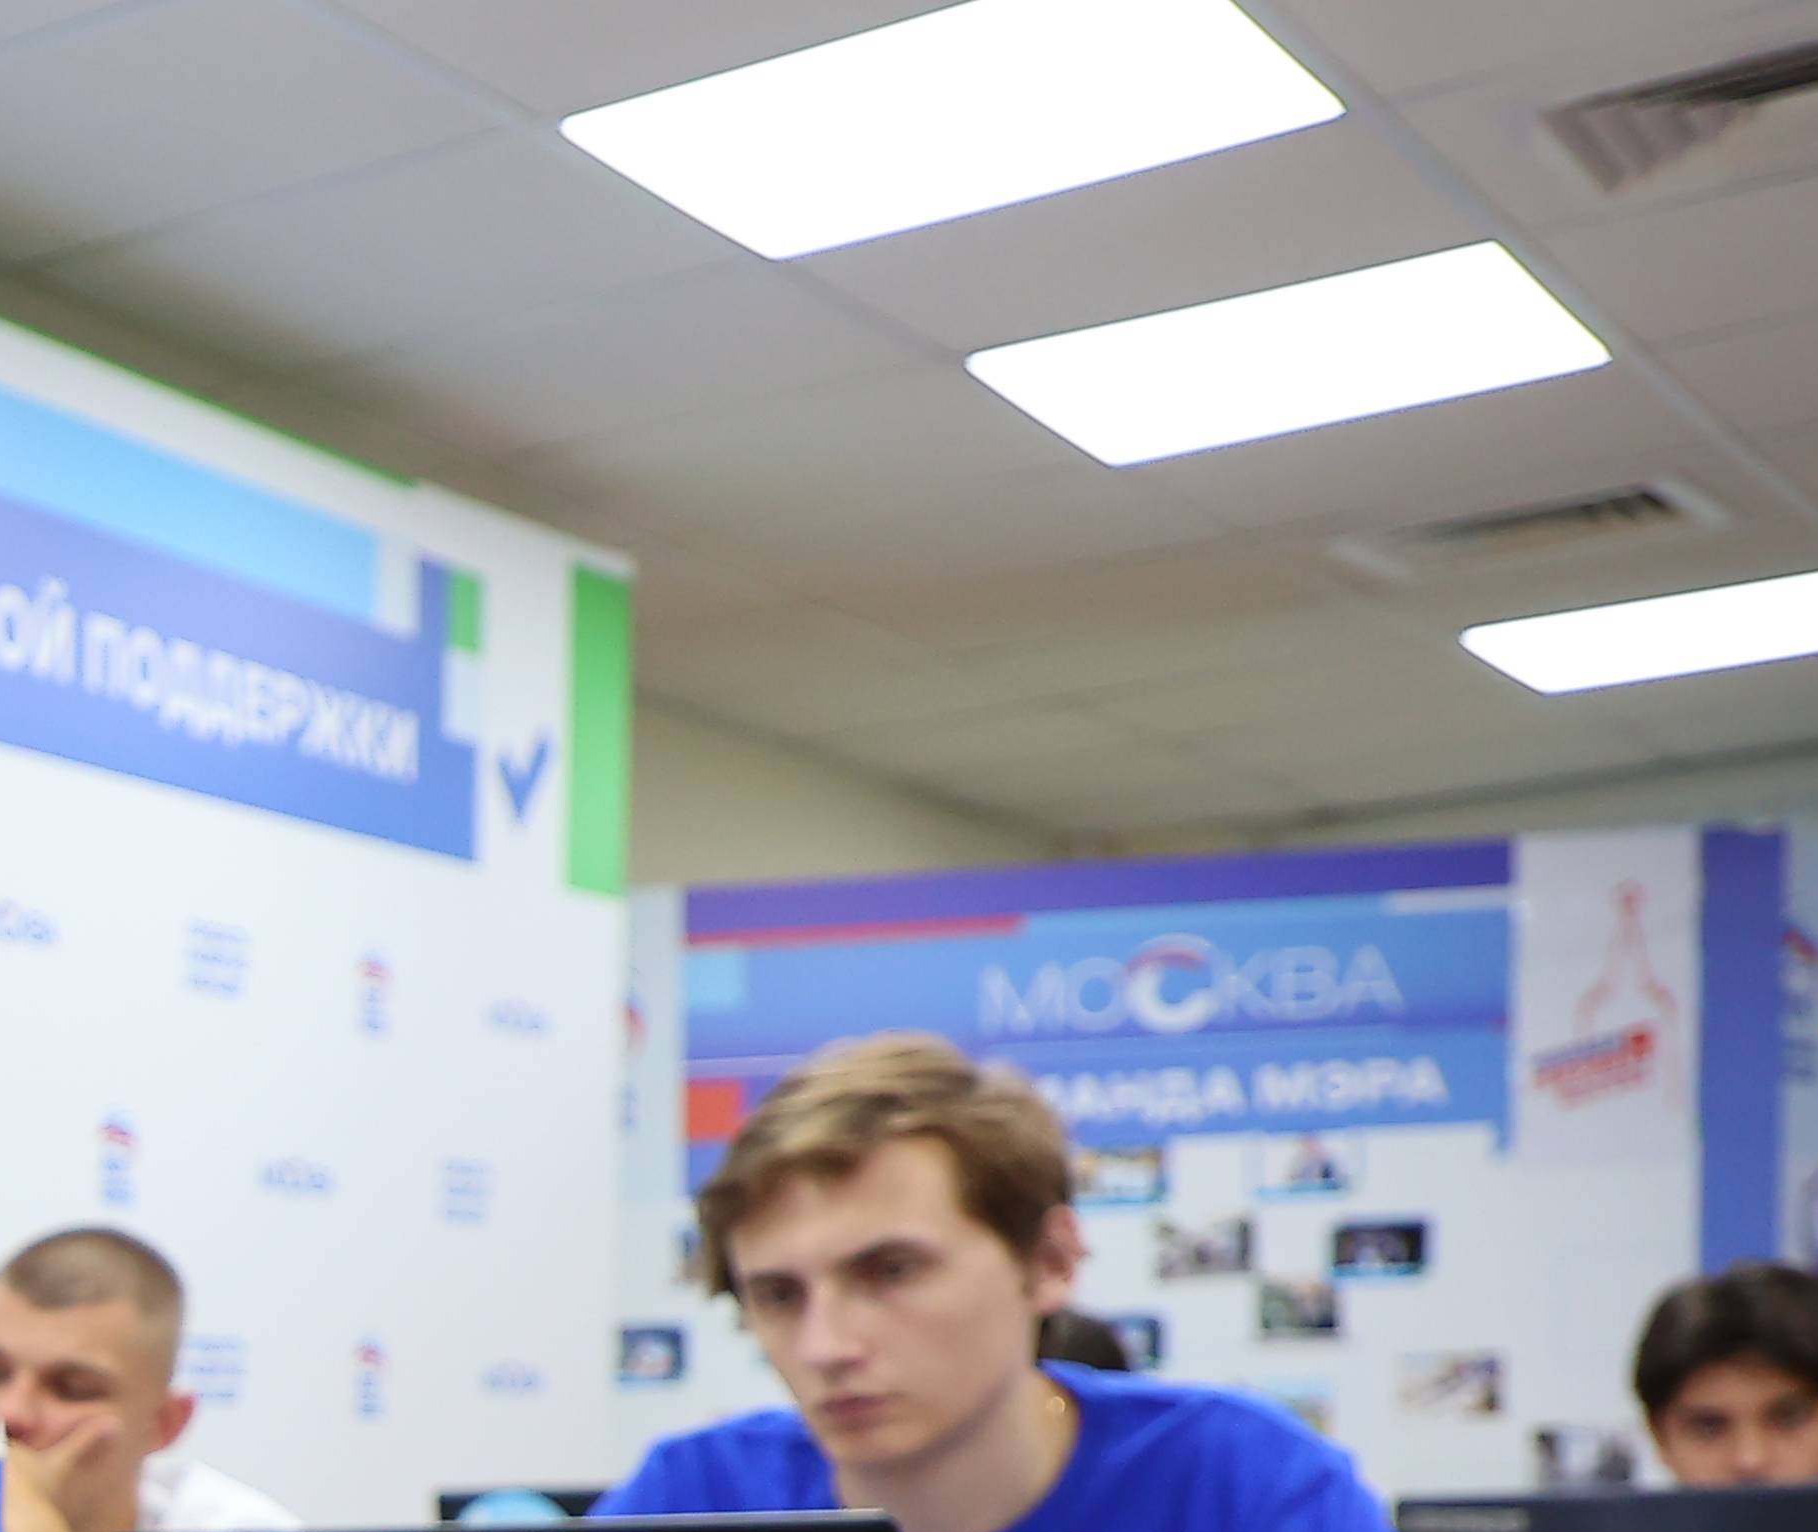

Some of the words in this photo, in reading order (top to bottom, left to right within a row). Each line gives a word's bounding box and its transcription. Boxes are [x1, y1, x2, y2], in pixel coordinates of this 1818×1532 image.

[82, 610, 421, 782] ПОДДЕРЖКИ
[976, 932, 1405, 1036] МОСКВА
[1045, 1064, 1248, 1125] АНДА
[1251, 1054, 1451, 1108] МЭРА
